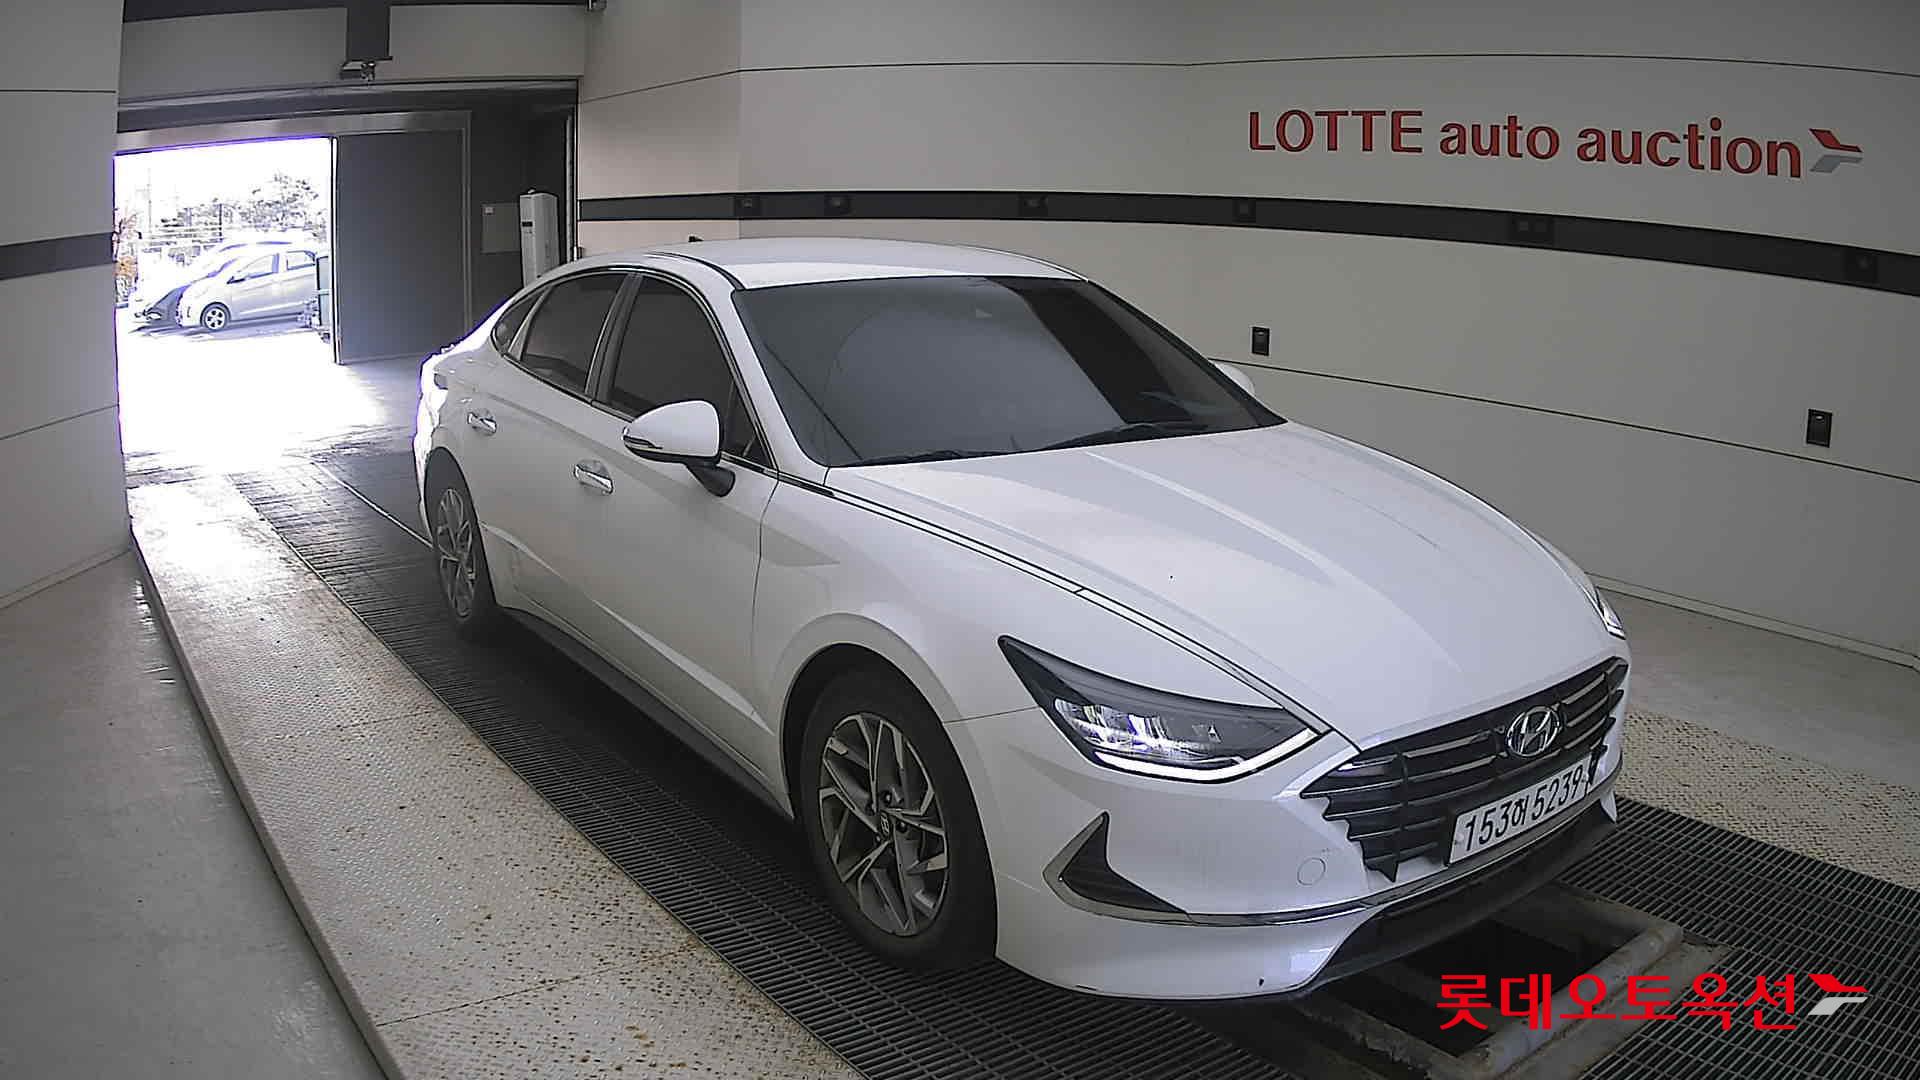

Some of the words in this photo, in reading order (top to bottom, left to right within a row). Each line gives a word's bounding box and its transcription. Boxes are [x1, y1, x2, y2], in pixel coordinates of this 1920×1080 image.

[1249, 110, 1424, 153] LOTTE
[1439, 116, 1560, 159] auto
[1576, 117, 1801, 178] auction
[1531, 764, 1584, 821] 5239
